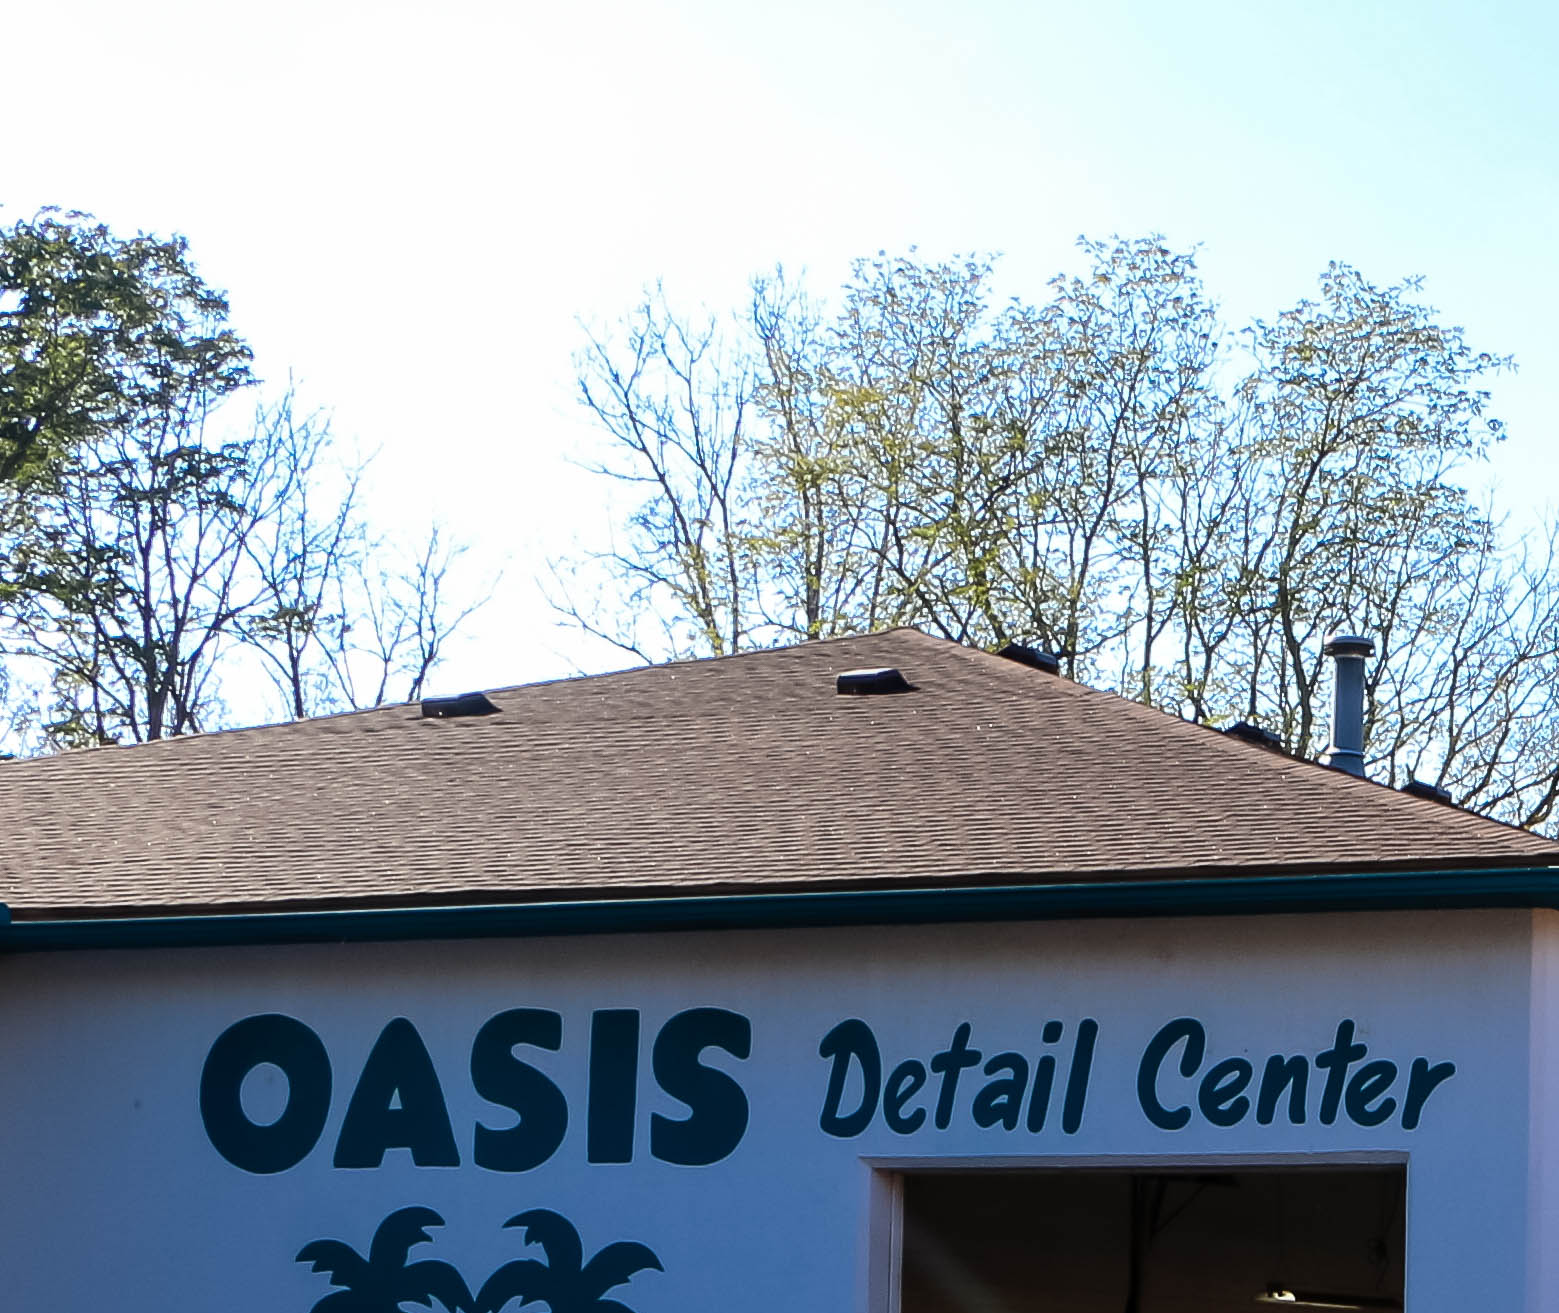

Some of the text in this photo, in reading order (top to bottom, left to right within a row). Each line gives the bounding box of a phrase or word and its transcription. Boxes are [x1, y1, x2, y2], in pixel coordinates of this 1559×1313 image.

[199, 1006, 752, 1175] OASIS
[818, 1016, 1457, 1138] Detail Center
